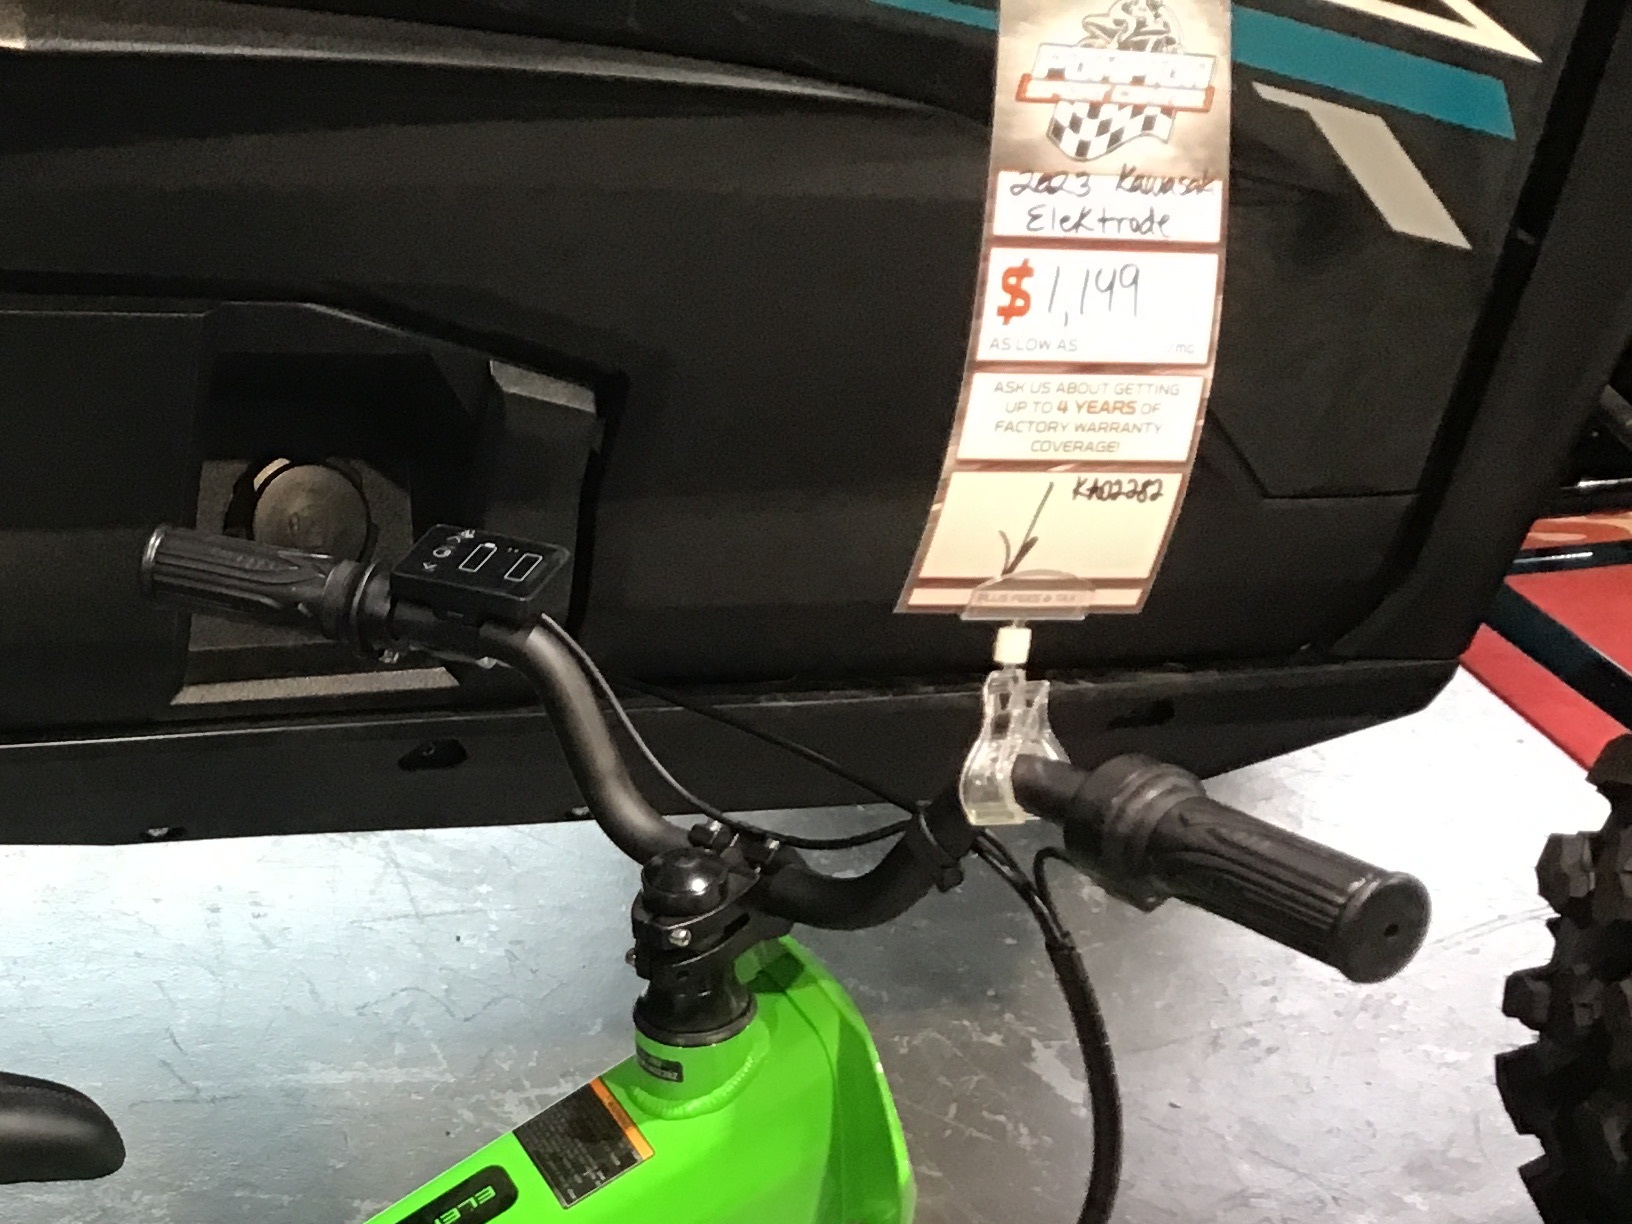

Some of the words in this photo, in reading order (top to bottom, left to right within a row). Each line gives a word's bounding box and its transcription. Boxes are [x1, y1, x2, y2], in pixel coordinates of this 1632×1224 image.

[1010, 171, 1091, 197] 2023
[989, 338, 1012, 351] AS
[1016, 338, 1051, 352] LOW
[1057, 338, 1078, 352] AS
[994, 381, 1025, 394] ASK
[1030, 382, 1051, 394] US
[1056, 382, 1108, 395] ABOUT
[1114, 383, 1180, 396] GETTING
[1005, 401, 1027, 414] UP
[1033, 402, 1053, 414] TO
[1056, 401, 1068, 415] 4
[1076, 400, 1137, 415] YEARS
[1140, 403, 1162, 415] OF
[994, 420, 1070, 433] FACTORY
[1074, 421, 1163, 434] WARRANTY
[1030, 440, 1120, 453] COVERAGE!
